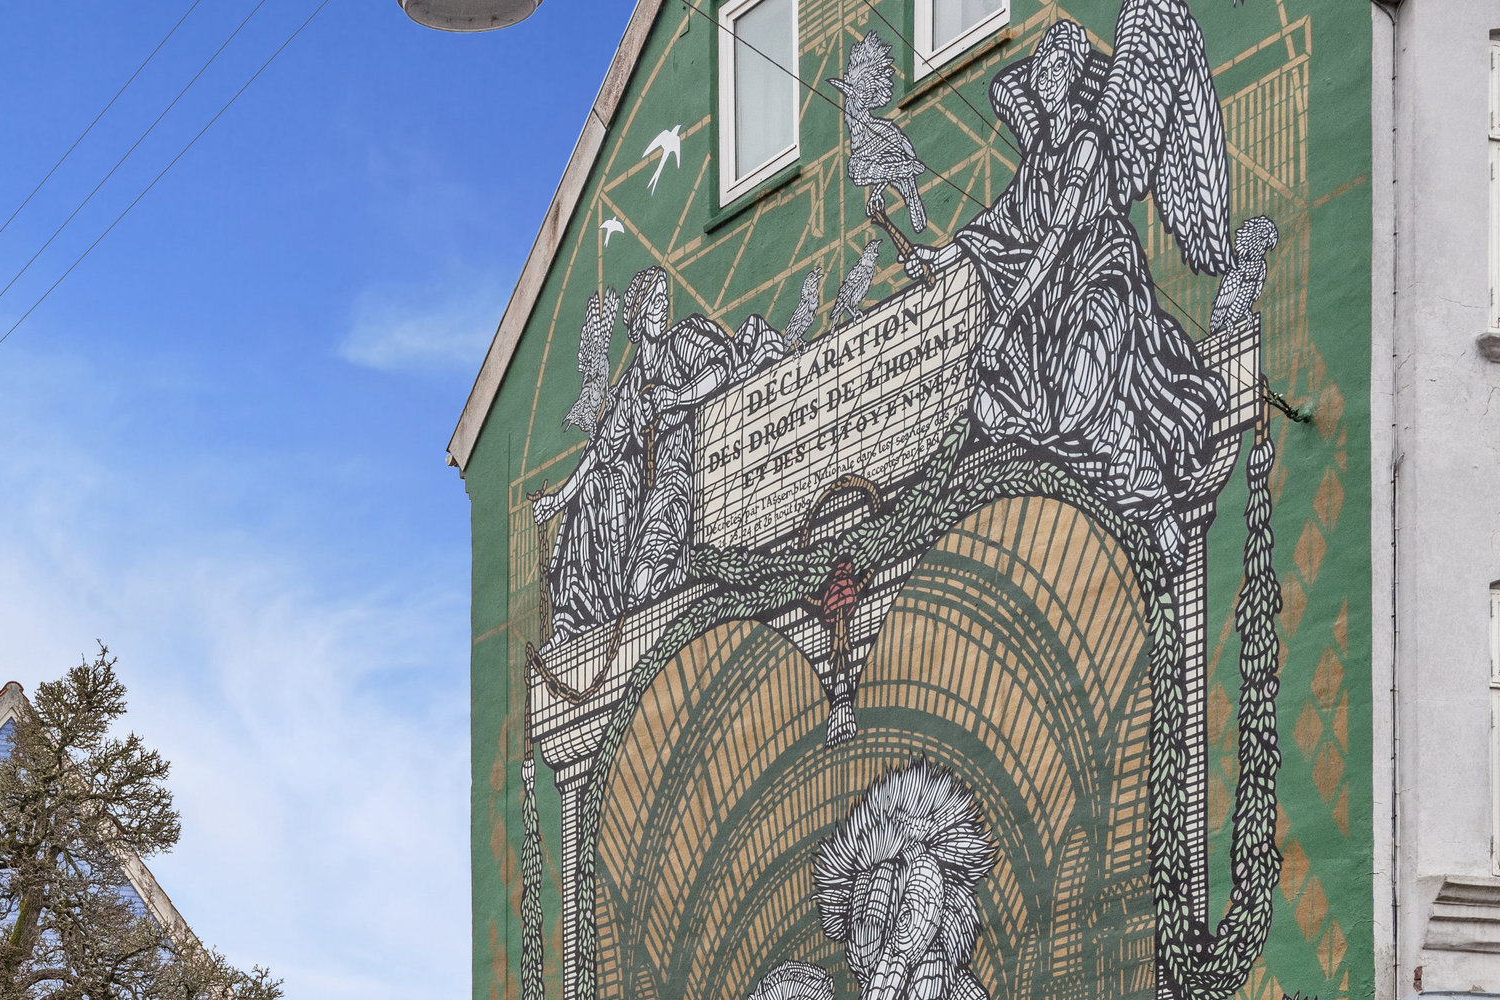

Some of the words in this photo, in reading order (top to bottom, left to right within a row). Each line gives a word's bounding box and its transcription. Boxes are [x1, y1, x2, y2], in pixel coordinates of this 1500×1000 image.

[746, 301, 922, 417] DÉCLARATION
[707, 439, 741, 474] DES
[747, 397, 818, 454] DROITS
[826, 378, 856, 413] DE
[742, 462, 767, 490] ET
[772, 442, 806, 475] DES
